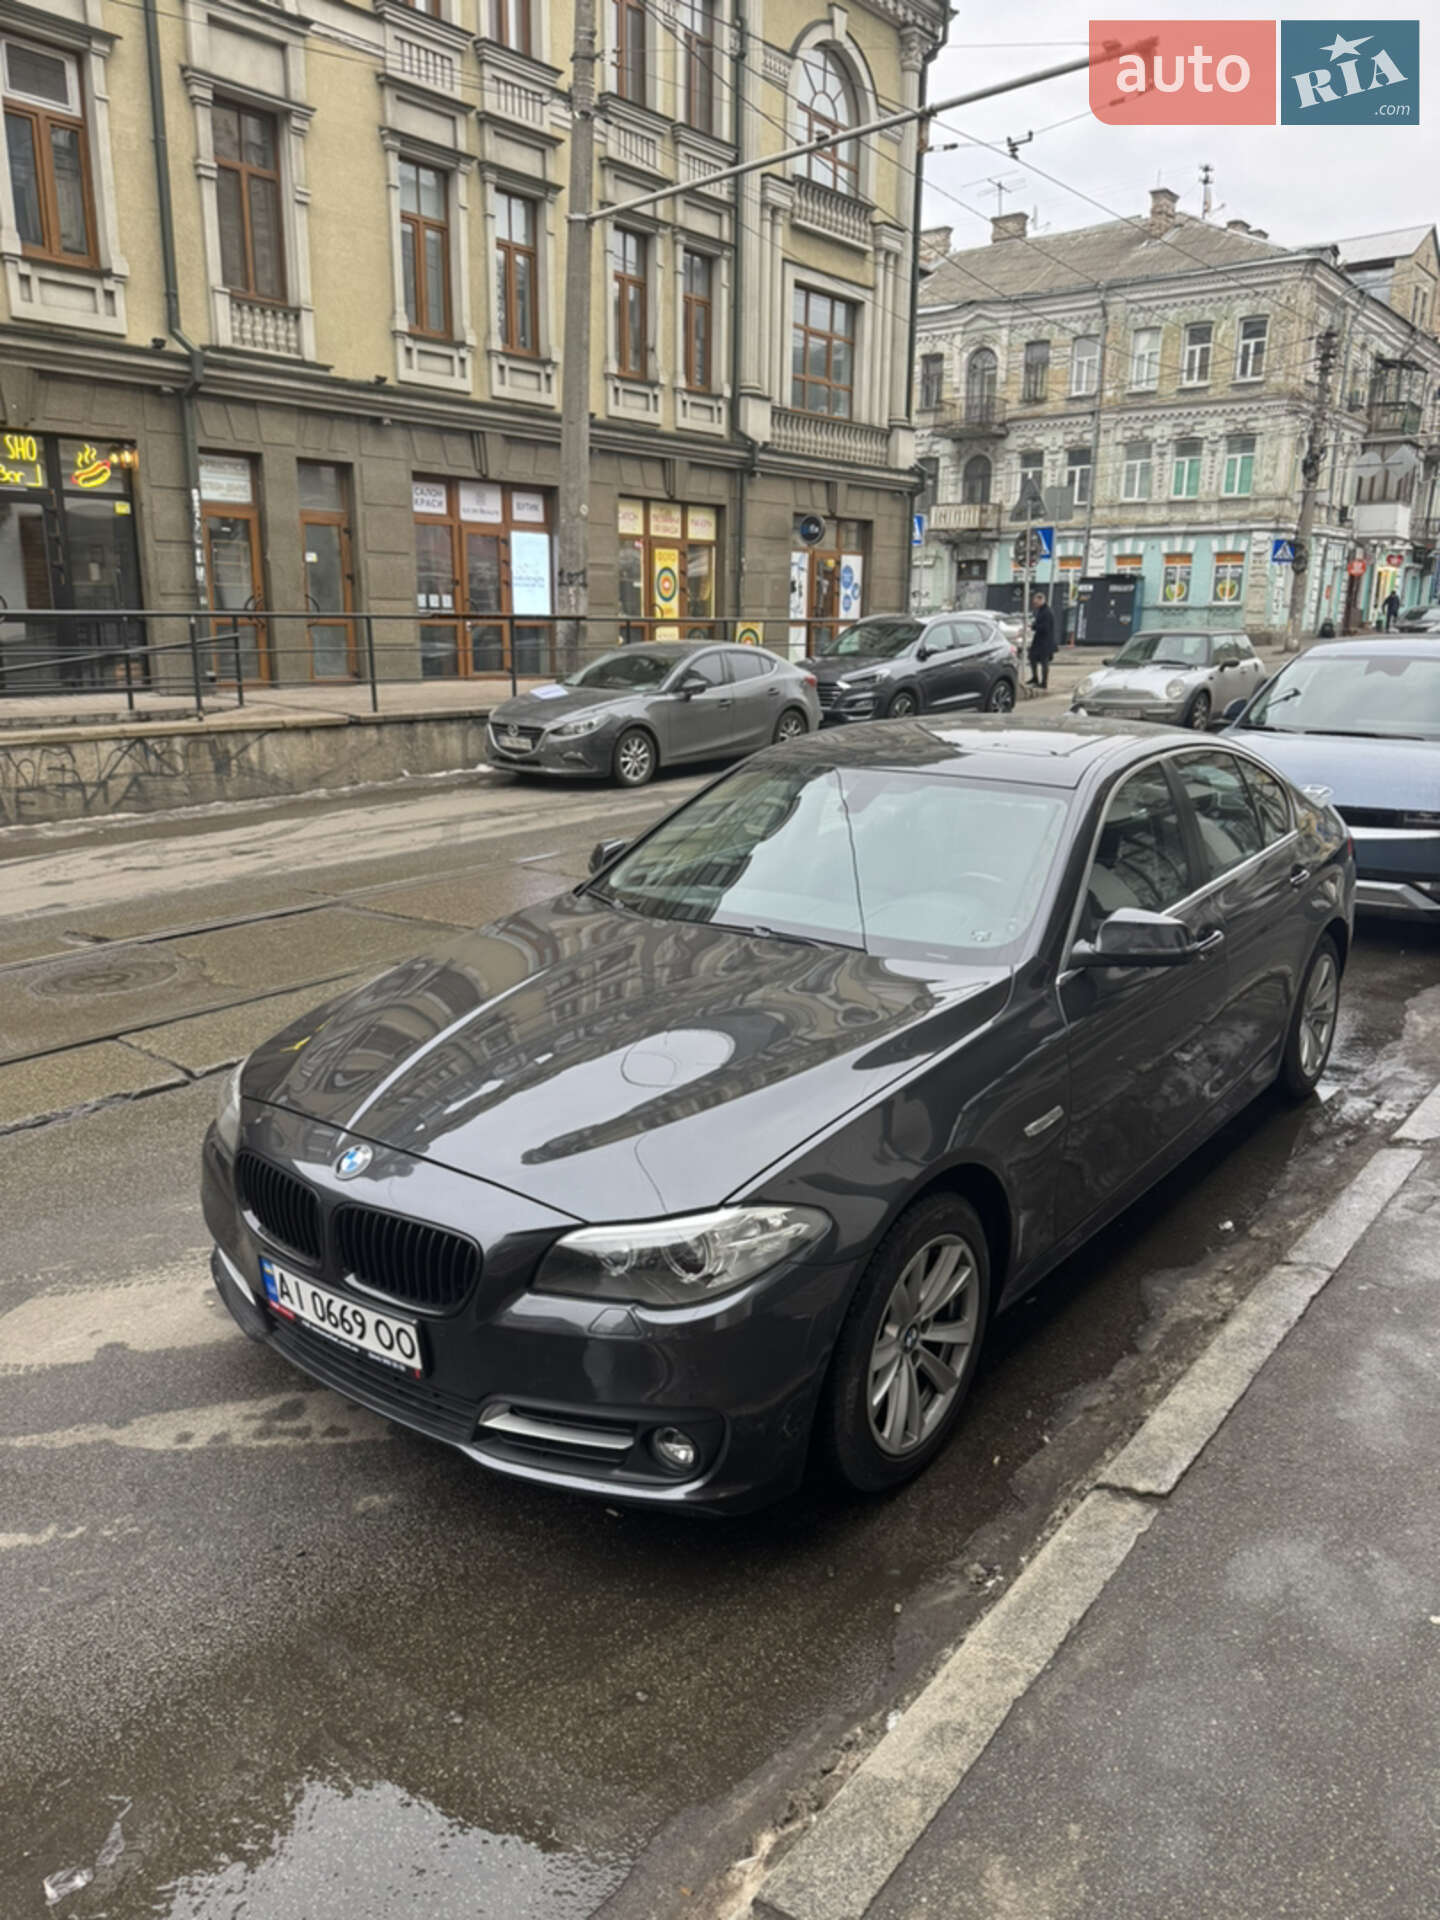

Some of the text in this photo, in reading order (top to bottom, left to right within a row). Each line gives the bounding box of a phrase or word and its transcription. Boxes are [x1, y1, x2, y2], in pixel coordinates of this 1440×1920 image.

[279, 1272, 304, 1311] AI
[311, 1291, 366, 1340] 0669
[375, 1319, 416, 1360] OO
